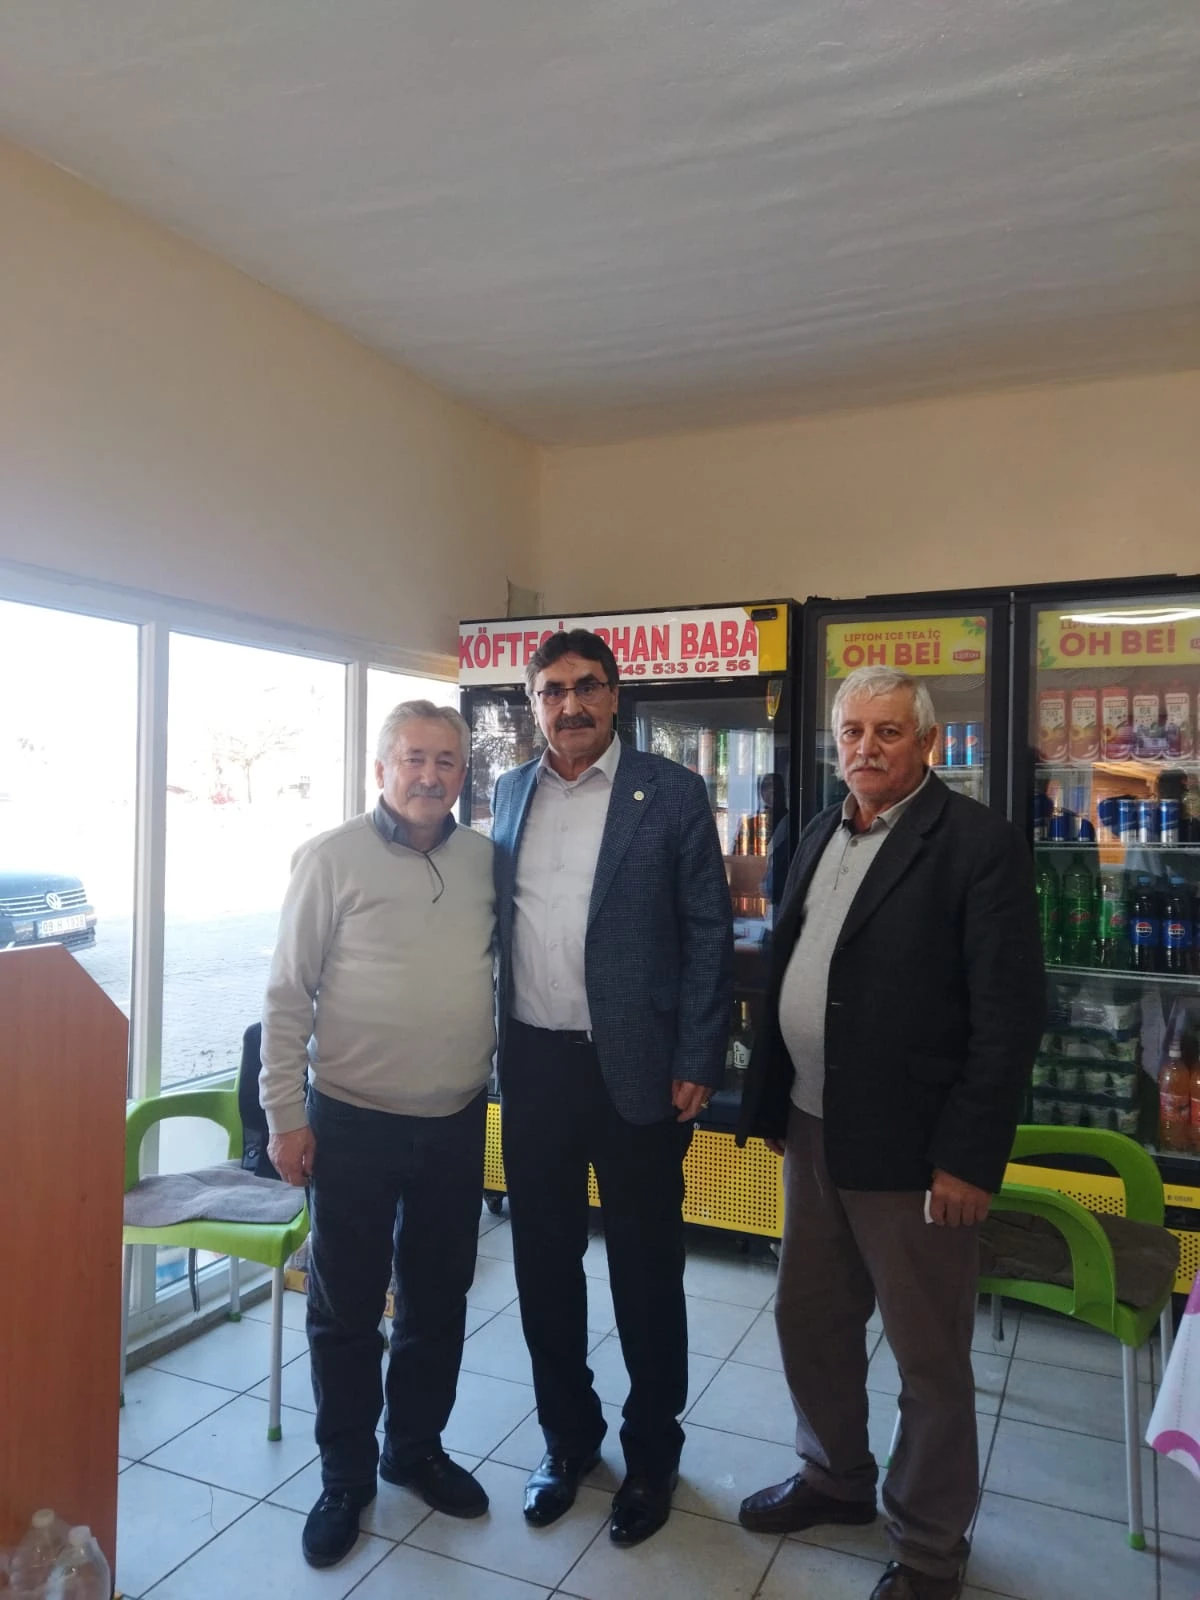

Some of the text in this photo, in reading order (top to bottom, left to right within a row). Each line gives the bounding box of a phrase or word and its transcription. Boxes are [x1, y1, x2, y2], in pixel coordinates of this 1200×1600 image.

[458, 619, 758, 669] KÖFTE HAN BABA
[844, 628, 941, 642] LIPTON ICE TEA İÇ
[1060, 628, 1176, 657] OH BE!
[652, 662, 689, 675] 533
[695, 660, 719, 673] 02
[726, 659, 751, 671] 56
[843, 642, 941, 667] OH BE!
